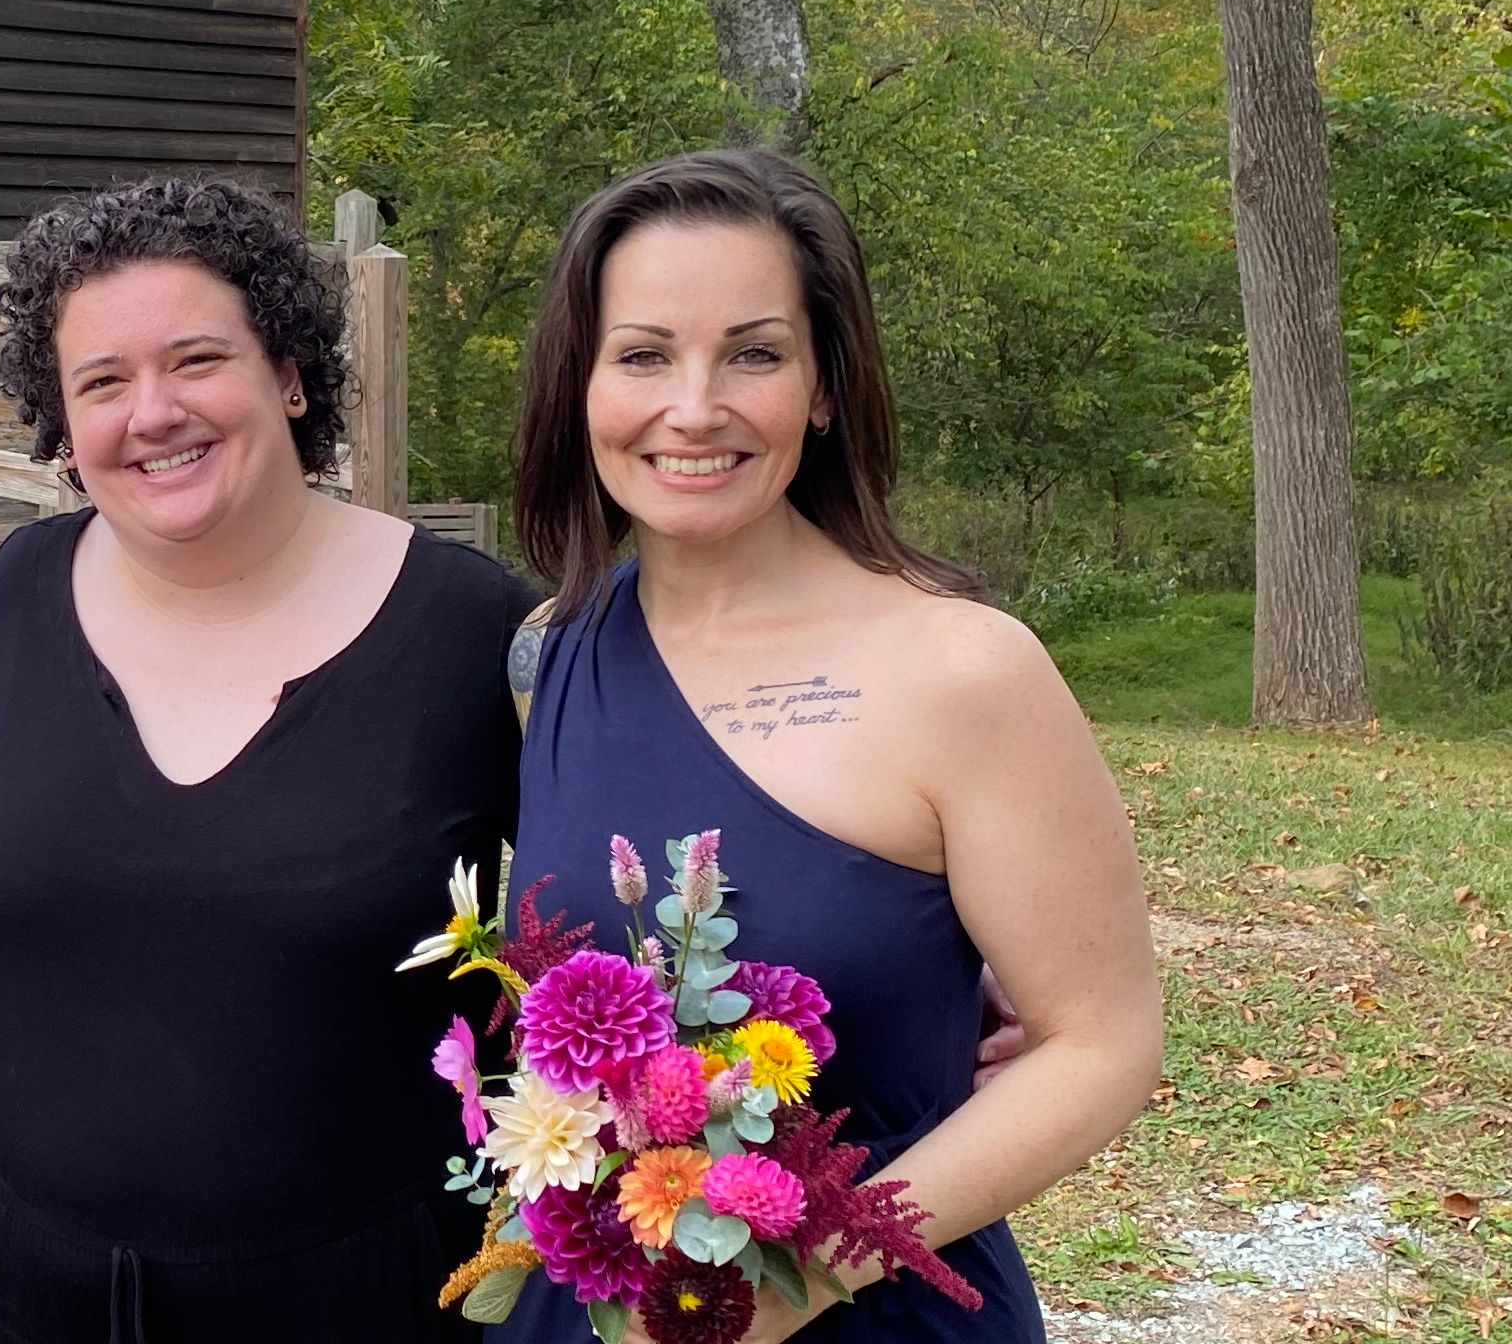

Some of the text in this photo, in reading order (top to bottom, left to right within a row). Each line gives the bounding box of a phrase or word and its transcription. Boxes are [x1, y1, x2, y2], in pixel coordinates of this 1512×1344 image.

[702, 685, 863, 721] you are precious
[726, 719, 745, 734] to
[751, 721, 778, 740] my
